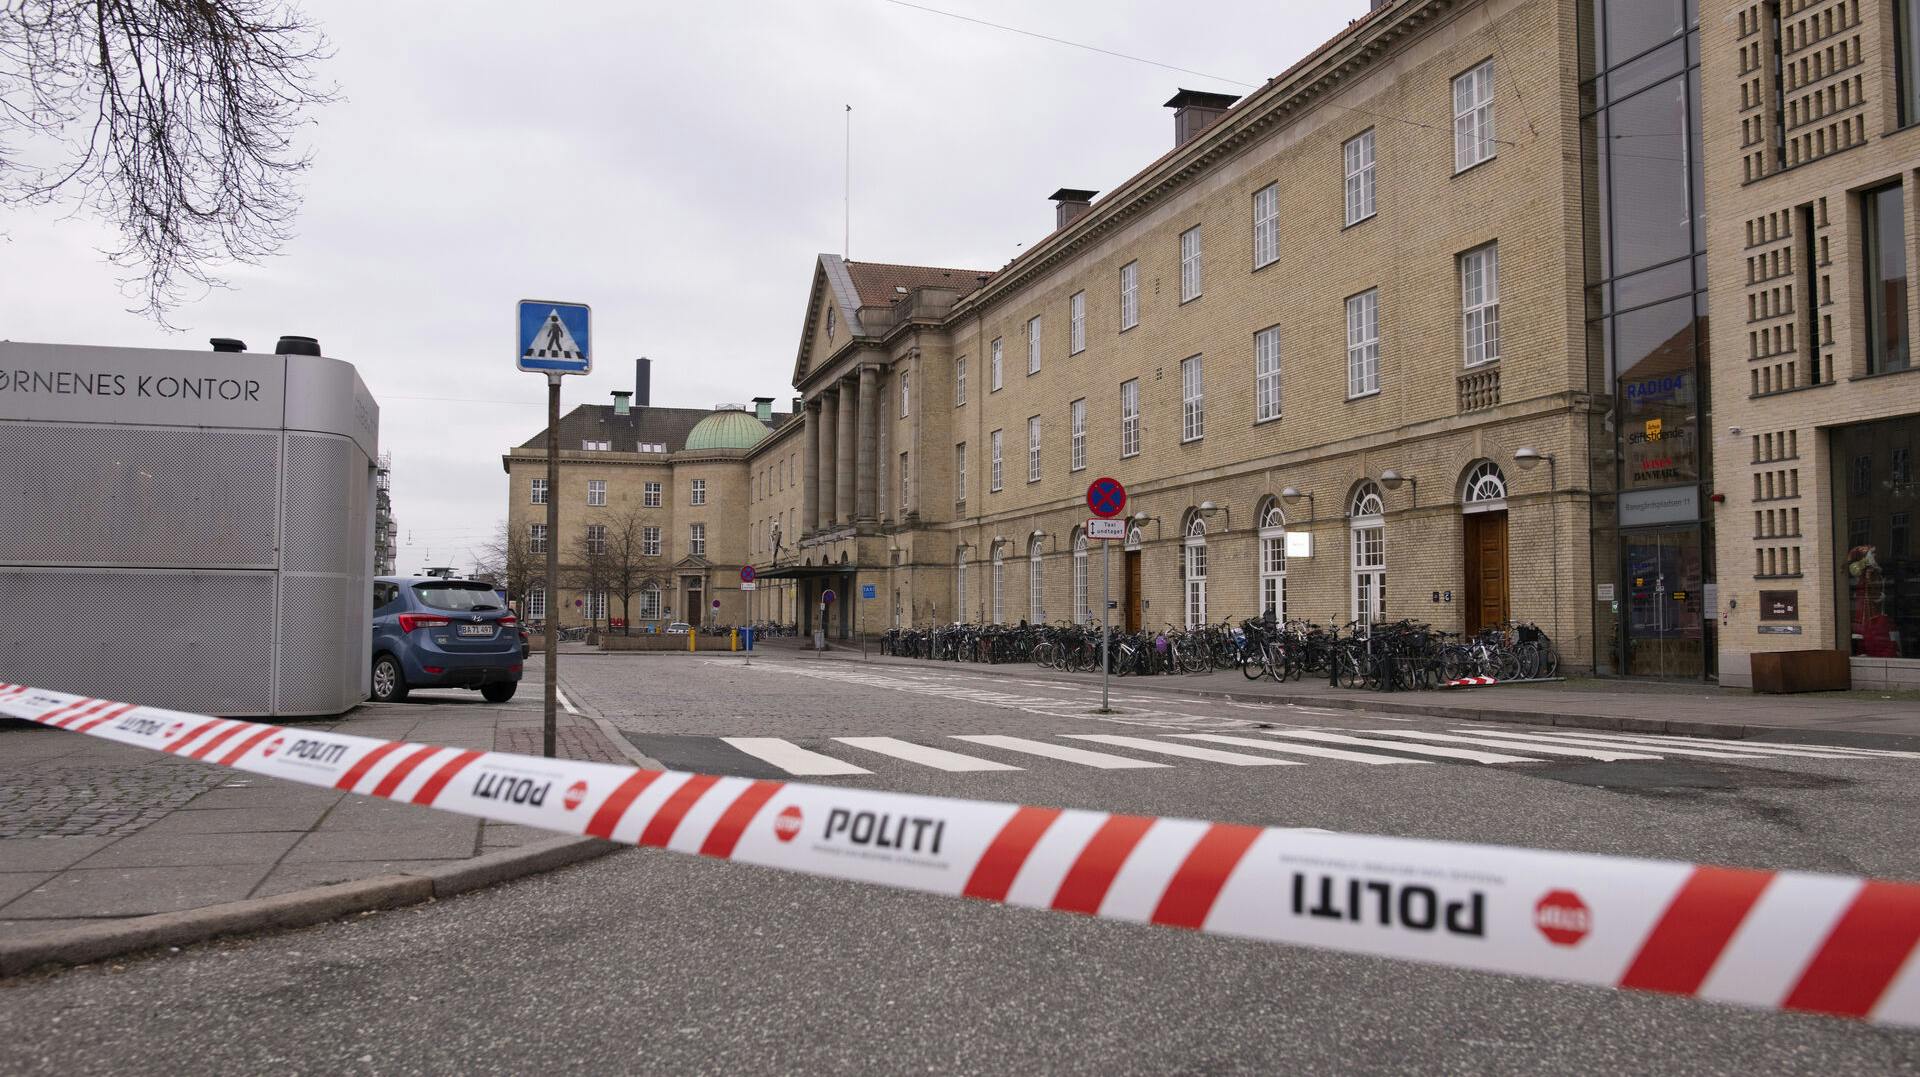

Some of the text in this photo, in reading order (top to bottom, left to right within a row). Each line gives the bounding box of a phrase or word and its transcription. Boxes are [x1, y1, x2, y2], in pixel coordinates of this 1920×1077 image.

[138, 376, 259, 401] KONTOR
[286, 739, 349, 764] POLITI
[472, 772, 552, 806] POLITI
[823, 807, 946, 854] POLITI
[1291, 872, 1487, 938] POLITI
